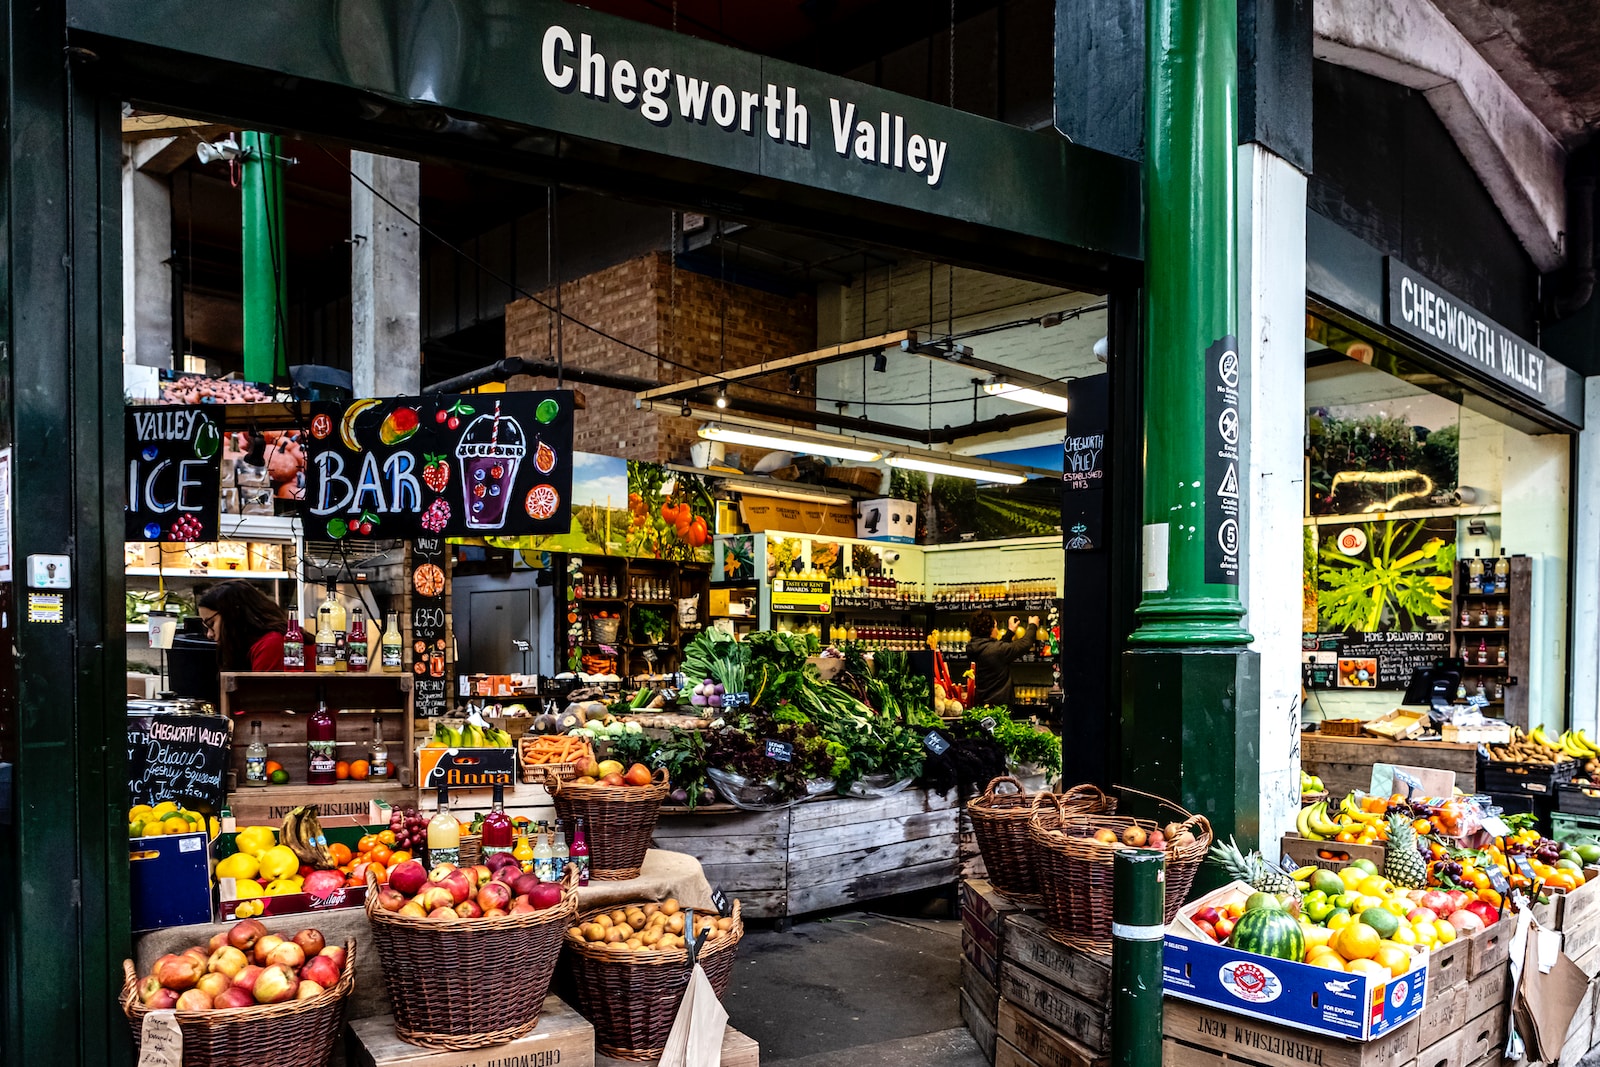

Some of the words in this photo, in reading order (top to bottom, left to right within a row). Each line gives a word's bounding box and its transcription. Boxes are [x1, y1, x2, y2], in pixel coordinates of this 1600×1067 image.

[541, 25, 810, 146] Chegworth
[829, 97, 947, 186] Valley
[1401, 276, 1496, 369] CHEGWORTH
[1499, 334, 1544, 394] VALLEY
[133, 410, 201, 441] VALLEY
[1064, 434, 1104, 453] CHEGWORTH
[310, 450, 422, 515] BAR
[1063, 470, 1103, 481] ESTABLISHED
[1072, 480, 1089, 489] 1983
[124, 459, 208, 513] ICE
[1227, 526, 1236, 544] 5
[1364, 632, 1385, 642] HOME
[1386, 631, 1424, 642] DELIVERY
[149, 721, 197, 743] CHEGWORTH
[198, 727, 227, 748] VALLEY
[447, 768, 510, 785] Anna
[268, 805, 297, 819] ENT
[316, 801, 370, 817] RRIETSHA
[1301, 859, 1340, 873] DEPOSIT
[1168, 942, 1188, 952] SELECTED
[1323, 1004, 1334, 1012] FOR
[1334, 1005, 1355, 1016] EXPORT
[1197, 1016, 1228, 1036] KENT
[1235, 1029, 1323, 1066] HARRIETSHAM
